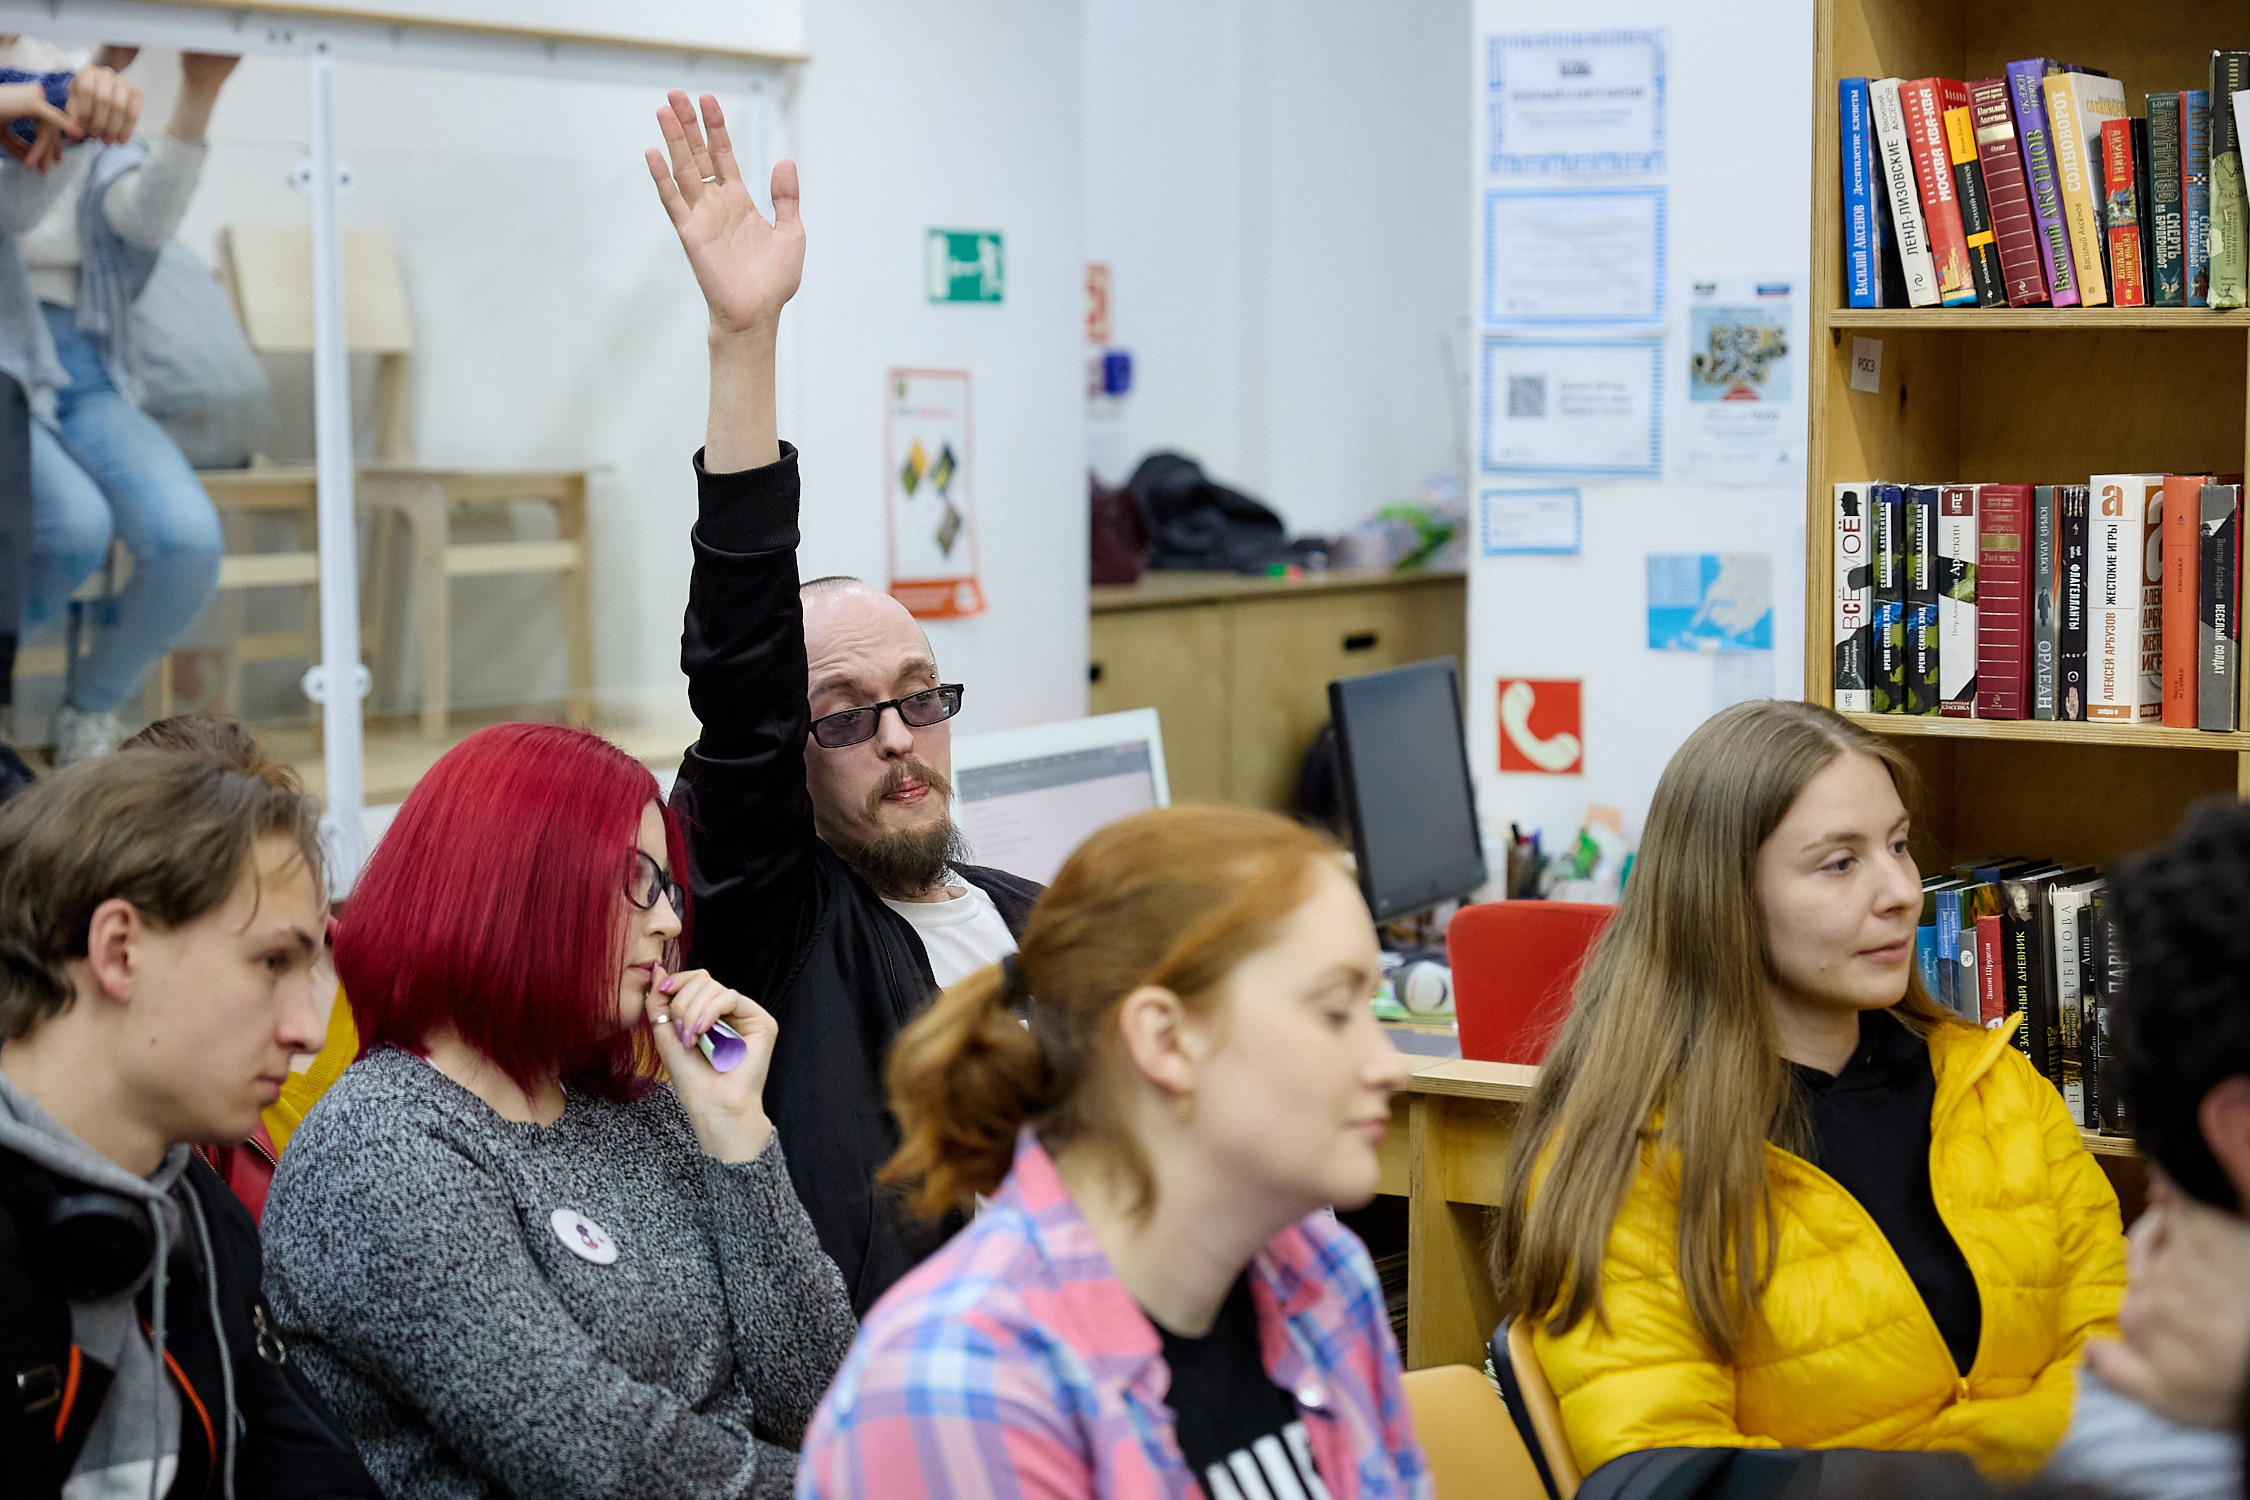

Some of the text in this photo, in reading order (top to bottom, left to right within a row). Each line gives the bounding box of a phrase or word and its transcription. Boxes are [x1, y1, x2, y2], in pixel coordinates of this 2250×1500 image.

[1850, 89, 1861, 131] клеветы
[2016, 74, 2031, 114] СКАЖИ
[2027, 75, 2040, 108] ИЗЮМ
[2152, 100, 2176, 108] БОРИС
[1852, 133, 1864, 197] Десятилетие
[1919, 88, 1952, 202] МОСКВА КВА-КВА
[2051, 91, 2081, 192] СОЛНОВОРОТ
[2111, 129, 2126, 175] АКУНИН
[2152, 109, 2179, 179] АКУНИН
[2189, 105, 2209, 172] АКУНИН
[1886, 139, 1919, 256] ЛЕНД-ЛИЗОВСКИЕ
[1969, 197, 1982, 231] ВАСИЛИЙ
[1853, 204, 1867, 249] АКСЕНОВ
[2079, 237, 2092, 270] Василий
[2155, 203, 2168, 269] НА БРУДЕРШАФТ
[2167, 212, 2182, 260] СМЕРТЬ
[2189, 210, 2199, 268] НА БРУДЕРШАФТ
[2199, 215, 2210, 263] СМЕРТЬ
[2115, 242, 2126, 280] ВРЕМЕНИ
[2125, 260, 2135, 287] ИНОГО
[1949, 525, 1964, 576] Арлекин
[2040, 506, 2050, 575] ЮРИЙ АРАБОВ
[1838, 518, 1861, 630] ВСЁ МОЁ
[1879, 550, 1887, 588] СВЕТЛАНА
[2069, 564, 2081, 630] ФЛАГЕЛЛАНТЫ
[2103, 524, 2118, 701] АЛЕКСЕЙ АРБУЗОВ ЖЕСТОКИЕ ИГРЫ
[2212, 538, 2227, 675] Виктор Астафьев ВЕСЕЛЫЙ СОЛДАТ
[1882, 604, 1892, 671] ВРЕМЯ СЕКОНД ХЭНД
[1918, 607, 1927, 674] ВРЕМЯ СЕКОНД ХЭНД
[2037, 640, 2053, 709] ОРЛЕАН
[2015, 931, 2027, 982] ДНЕВНИК
[2061, 905, 2077, 1012] БЕРБЕРОВА
[2081, 936, 2091, 966] Анна
[1986, 977, 1994, 1000] Закон
